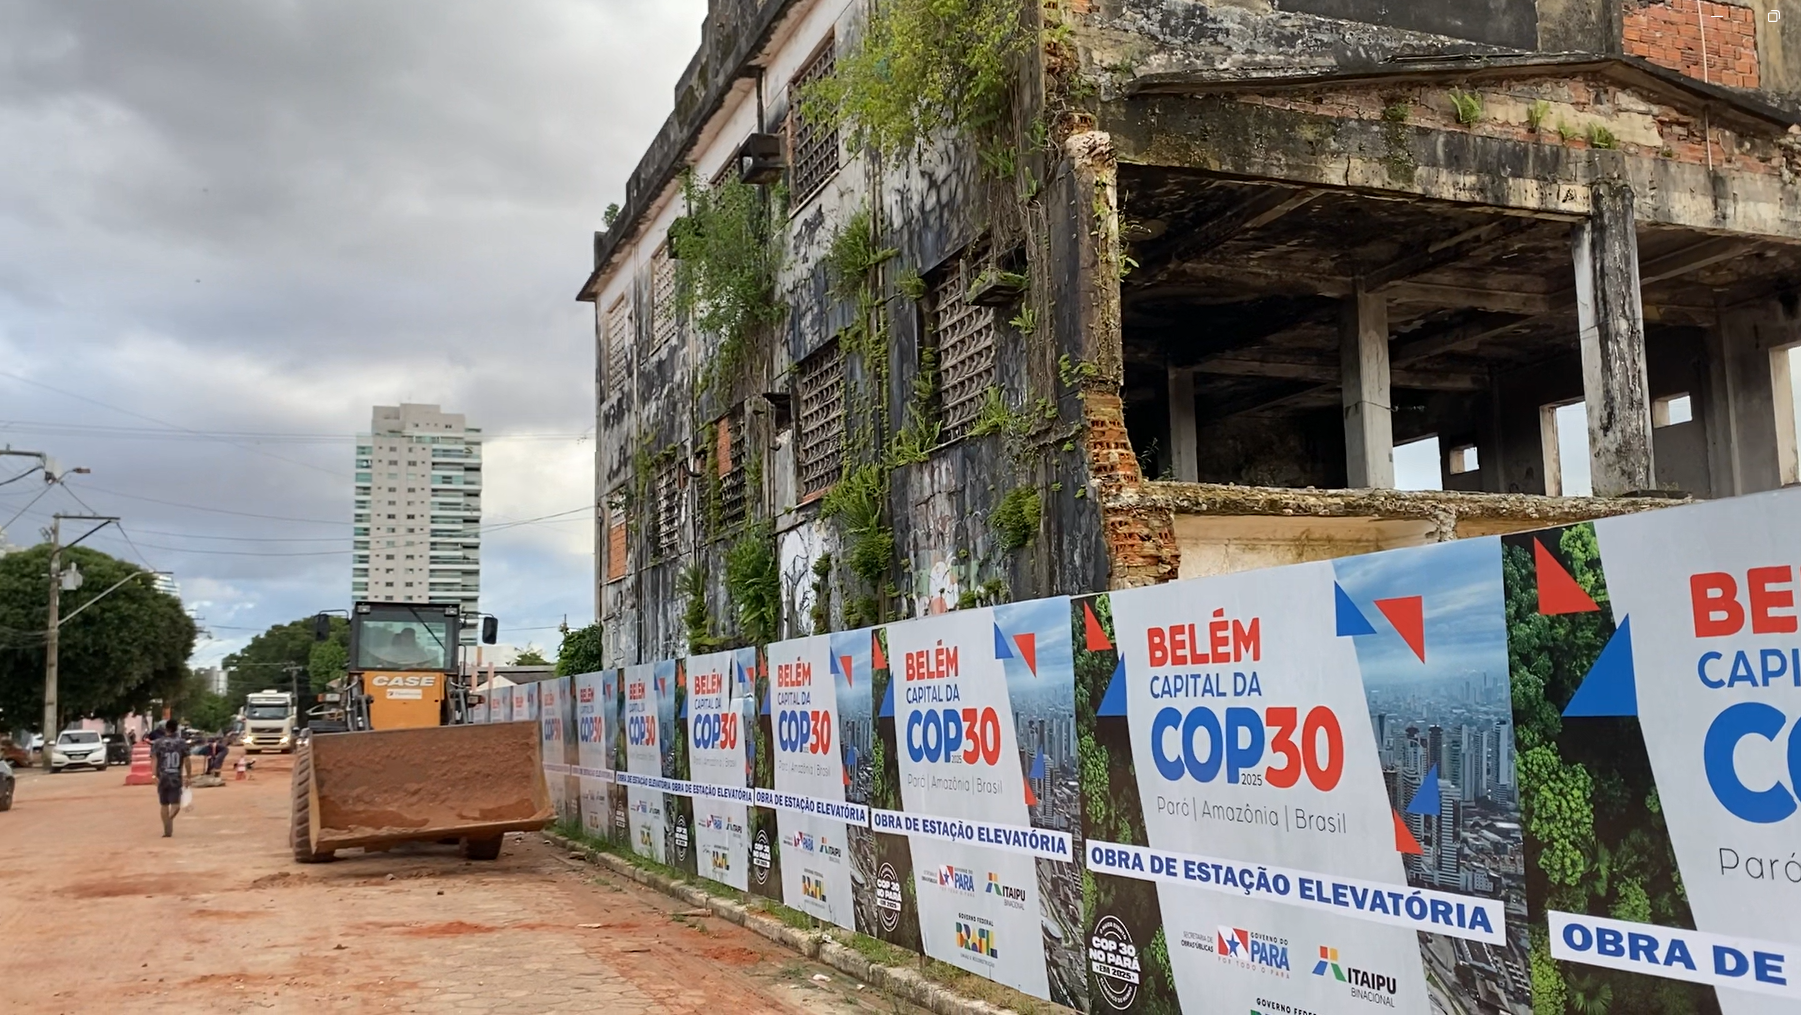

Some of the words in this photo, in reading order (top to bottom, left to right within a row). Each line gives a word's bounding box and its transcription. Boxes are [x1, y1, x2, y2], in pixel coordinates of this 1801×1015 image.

[1689, 564, 1801, 638] BE
[1147, 607, 1261, 668] BELÉM
[777, 656, 812, 687] BELÉM
[905, 639, 959, 682] BELÉM
[1697, 648, 1801, 689] CAPI
[372, 676, 436, 686] CASE
[694, 668, 723, 695] BELÉM
[906, 685, 943, 704] CAPITAL
[945, 683, 960, 702] DA
[1150, 672, 1227, 699] CAPITAL
[1233, 671, 1262, 697] DA
[580, 716, 603, 743] COP30
[629, 715, 656, 747] COP30
[693, 712, 738, 750] COP30
[778, 710, 832, 755] COP30
[907, 706, 1002, 766] COP30
[1151, 705, 1344, 792] COP30
[1703, 701, 1801, 824] C
[976, 777, 1003, 795] Brasil
[1241, 773, 1263, 787] 2025
[756, 791, 773, 804] OBRA
[774, 794, 784, 806] DE
[785, 796, 815, 813] ESTAÇÃO
[816, 801, 866, 822] ELEVATÓRIA
[1201, 800, 1279, 827] Amazônia
[1295, 808, 1347, 834] Brasil
[874, 813, 902, 829] OBRA
[905, 816, 920, 832] DE
[922, 819, 974, 842] ESTAÇÃO
[977, 826, 1068, 855] ELEVATÓRIA
[1002, 885, 1026, 902] ITAIPU
[1091, 846, 1144, 872] OBRA
[1150, 854, 1178, 877] DE
[1183, 859, 1291, 896] ESTAÇÃO
[1298, 877, 1494, 934] ELEVATÓRIA
[1091, 935, 1117, 952] COP
[1118, 942, 1136, 958] 30
[1250, 931, 1278, 944] GOVERNO
[1279, 938, 1289, 946] DO
[1562, 922, 1697, 971] OBRA
[1712, 944, 1788, 986] DE
[1088, 947, 1106, 963] NO
[1107, 951, 1141, 972] PARÁ
[1111, 968, 1132, 980] 2025
[1348, 967, 1397, 995] ITAIPU
[1256, 997, 1291, 1014] GOVERNO
[1350, 987, 1396, 1008] BINACIONAL
